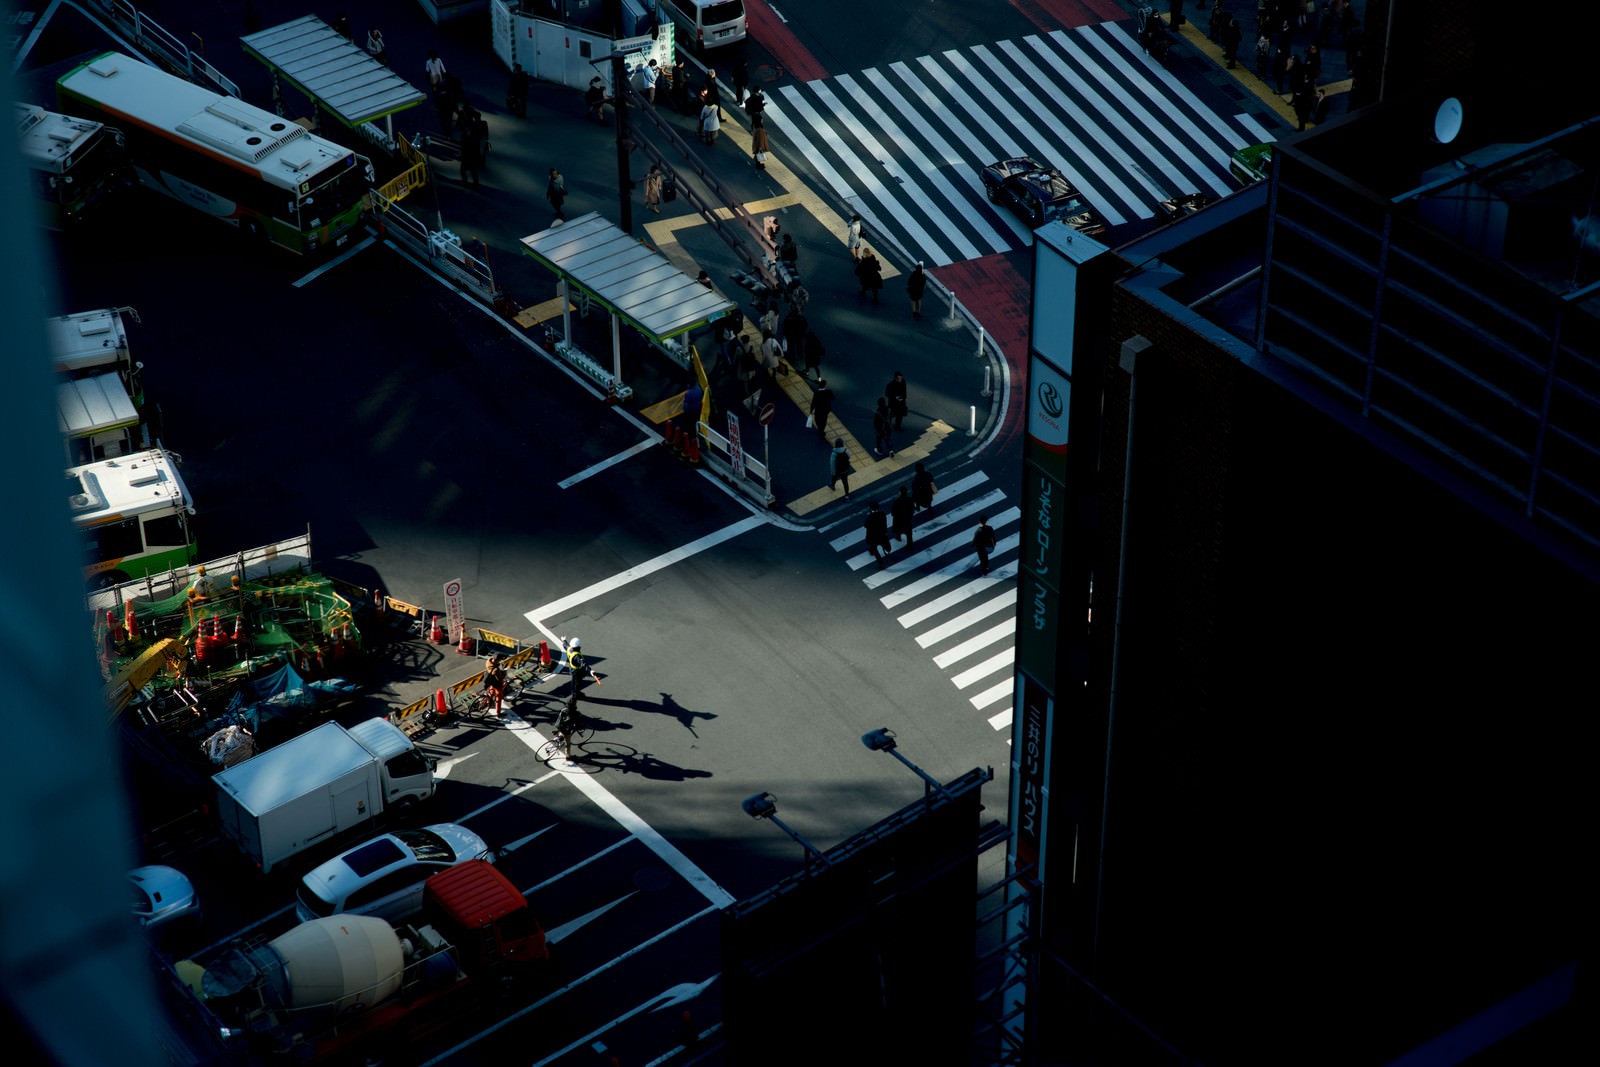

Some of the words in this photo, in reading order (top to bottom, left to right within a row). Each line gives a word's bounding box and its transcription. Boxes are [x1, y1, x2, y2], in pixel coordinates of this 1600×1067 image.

[1024, 704, 1040, 837] 三井のリハウス
